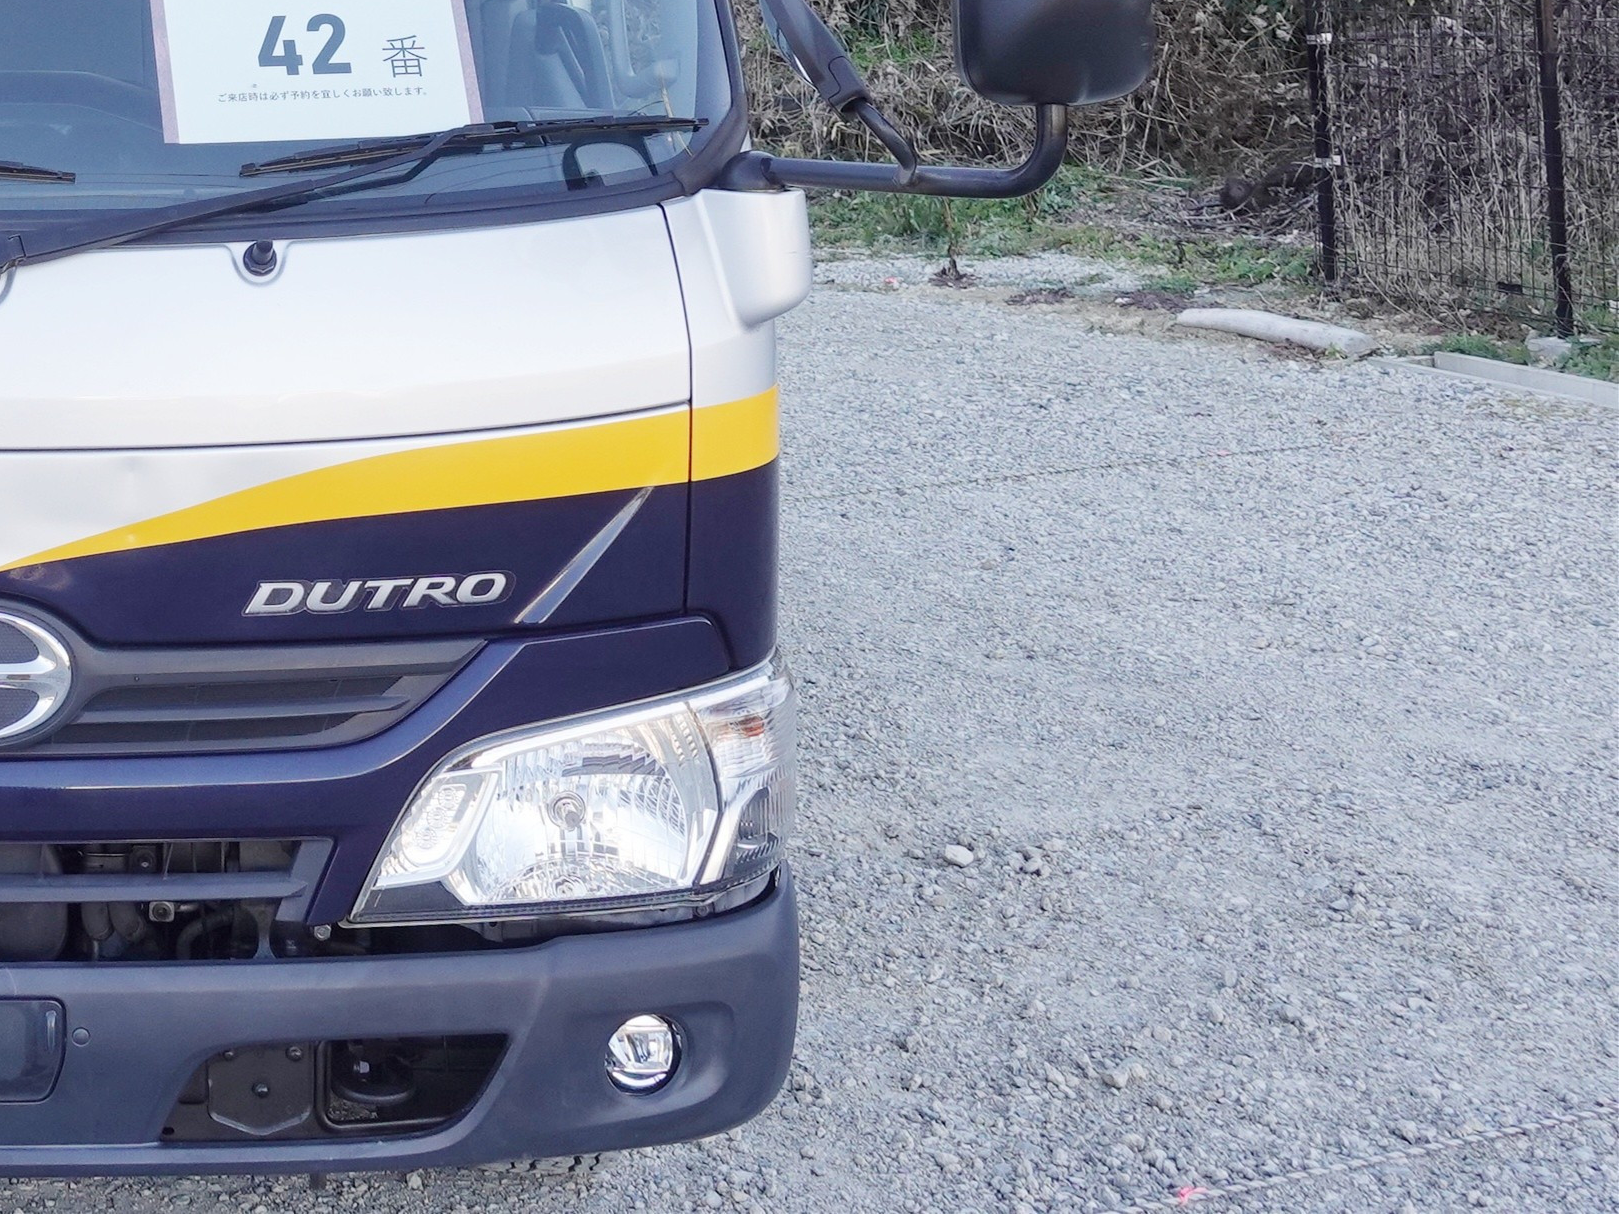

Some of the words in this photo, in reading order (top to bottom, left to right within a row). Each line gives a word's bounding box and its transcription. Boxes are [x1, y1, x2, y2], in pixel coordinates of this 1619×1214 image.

[258, 13, 352, 75] 42
[382, 34, 428, 78] 番
[245, 572, 507, 615] DUTRO
